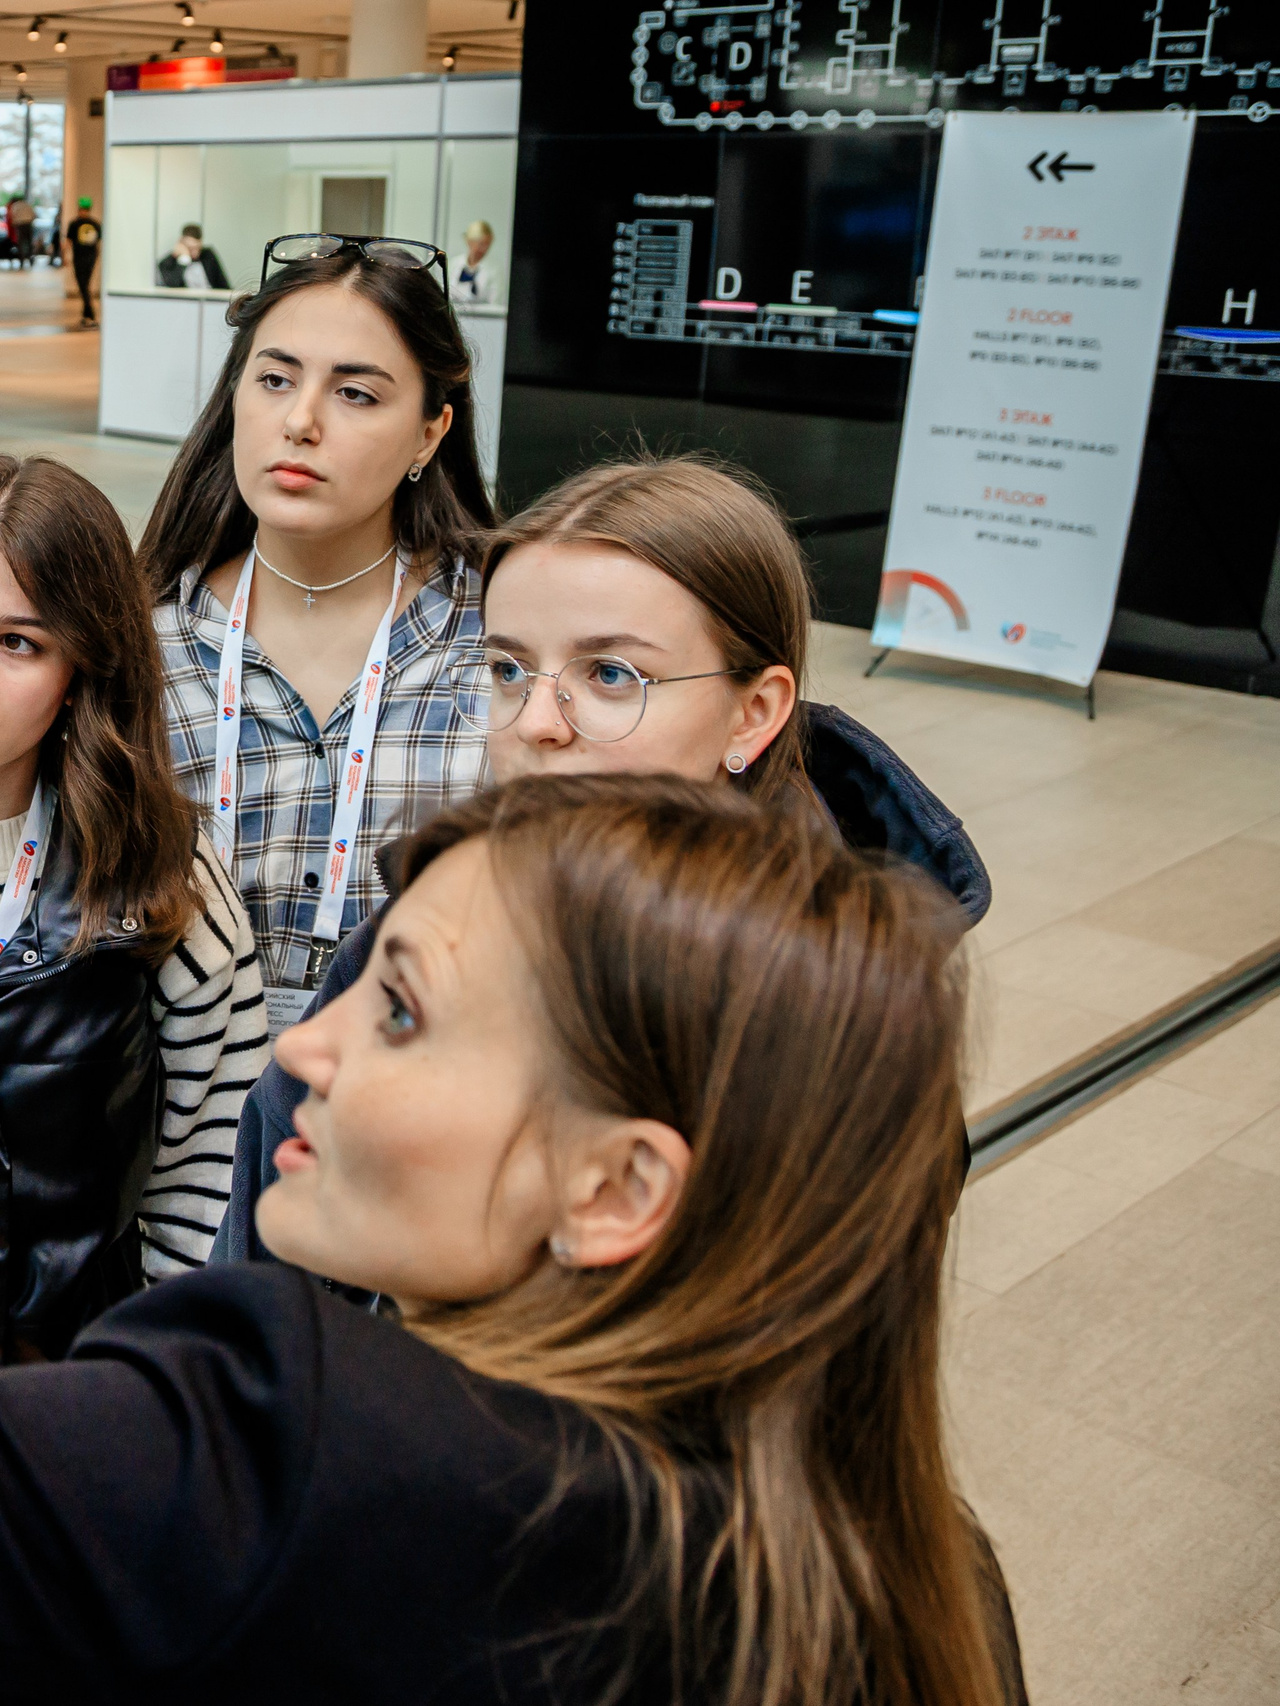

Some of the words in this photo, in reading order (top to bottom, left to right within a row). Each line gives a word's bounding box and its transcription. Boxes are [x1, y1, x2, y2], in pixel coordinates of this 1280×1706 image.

[675, 35, 694, 62] C
[729, 41, 753, 71] D
[1022, 226, 1032, 239] 2
[1037, 226, 1079, 242] ЭТАЖ
[716, 266, 742, 301] D
[791, 270, 815, 304] E
[1007, 307, 1015, 322] 2
[1019, 307, 1073, 326] FLOOR
[1221, 287, 1257, 325] H
[1012, 408, 1053, 426] ЭТАЖ
[994, 487, 1047, 508] FLOOR
[265, 992, 296, 1000] СИЙСКИЙ
